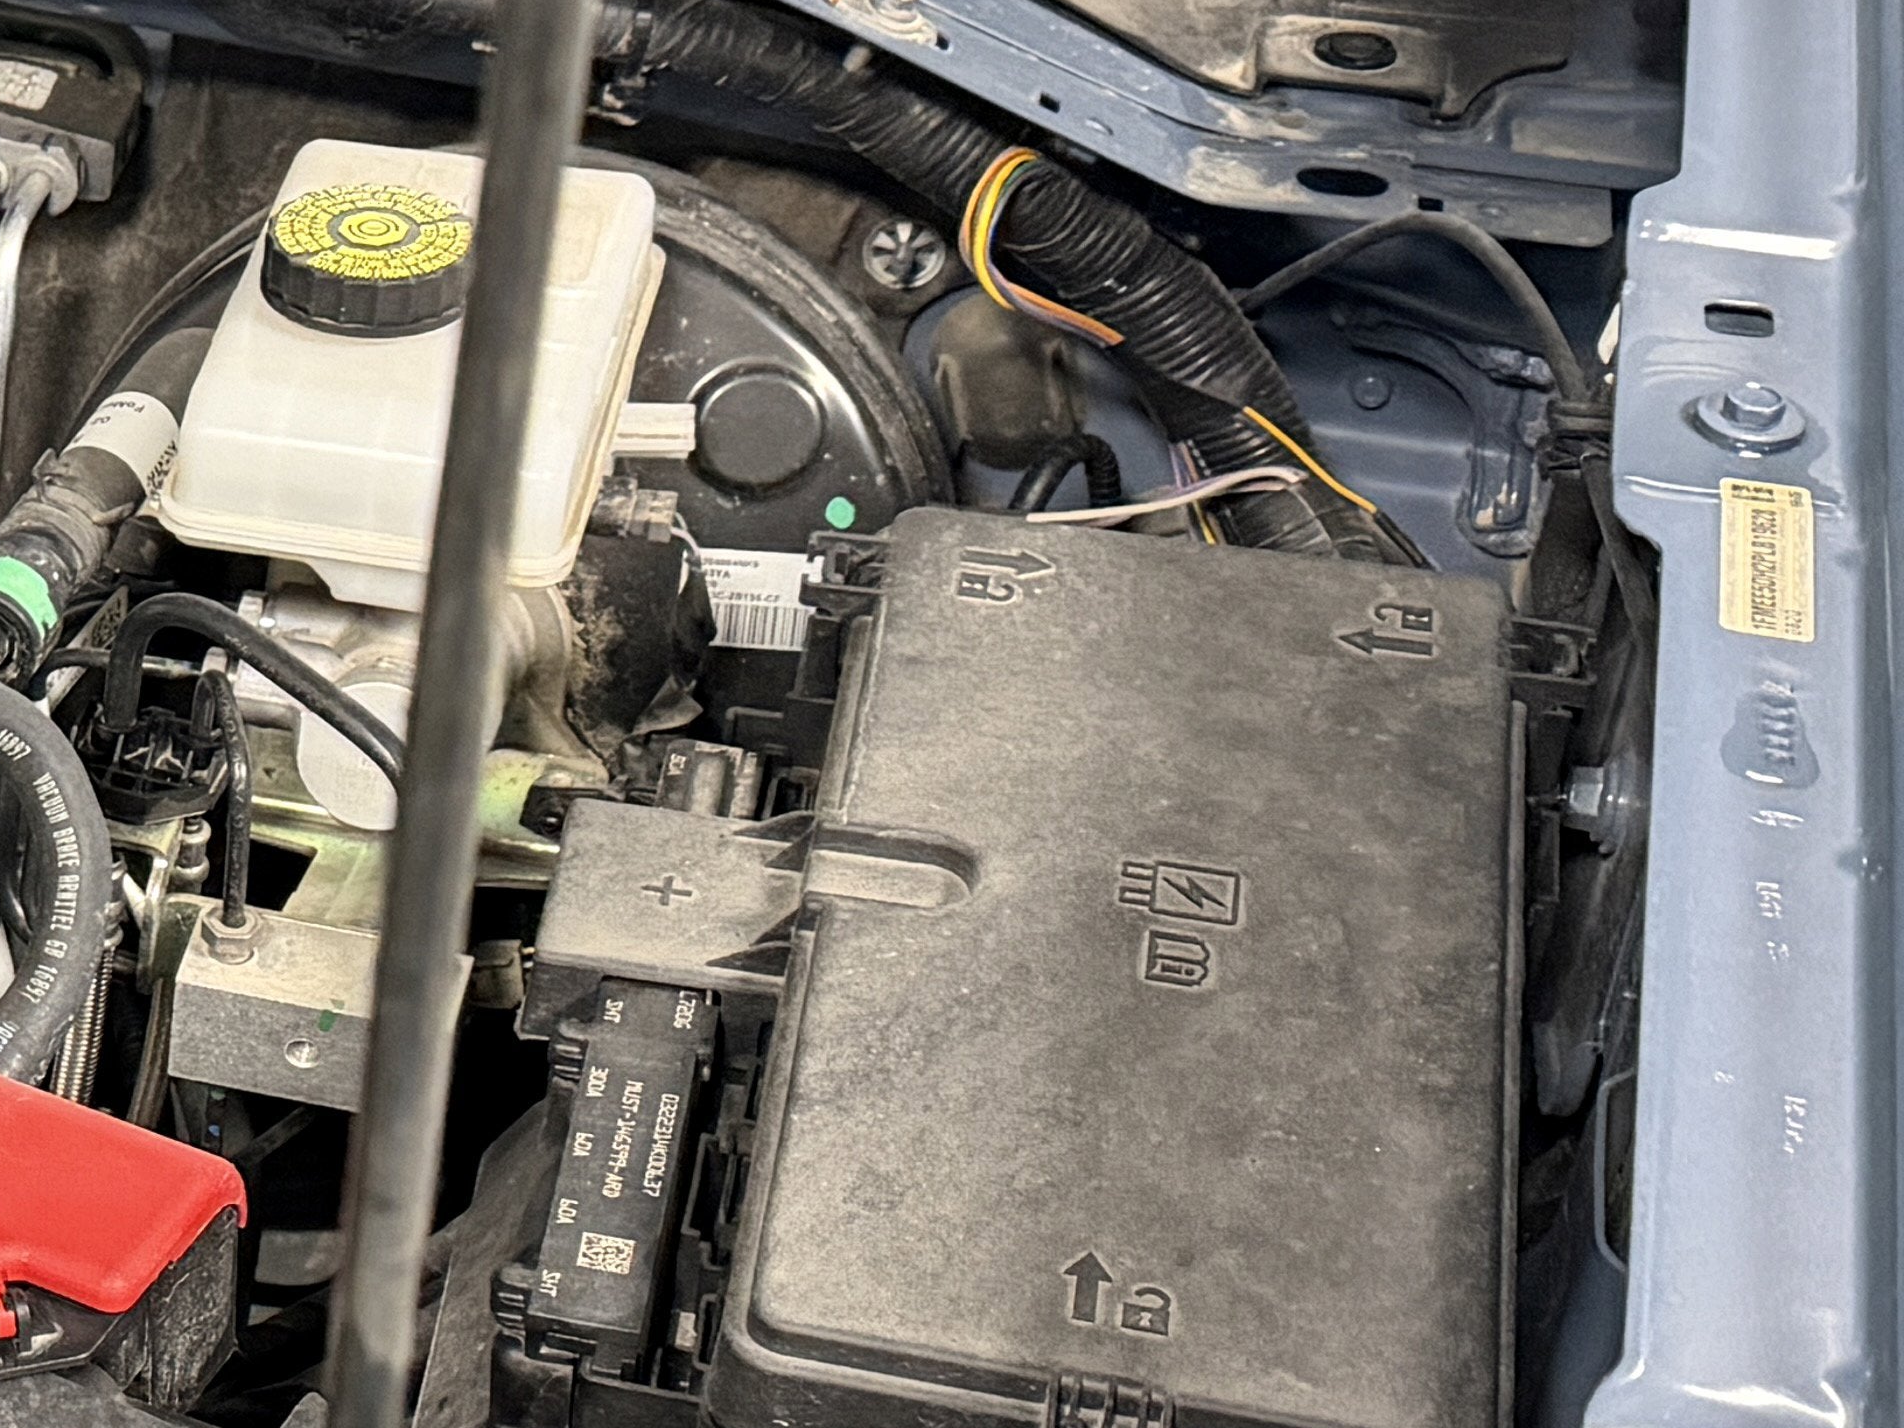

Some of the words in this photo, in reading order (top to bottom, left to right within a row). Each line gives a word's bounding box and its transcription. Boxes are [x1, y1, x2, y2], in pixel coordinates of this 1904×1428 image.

[32, 772, 68, 824] VACUUM
[51, 826, 79, 867] BRAKE
[49, 873, 78, 929] ARNITEL
[17, 964, 57, 1003] 16897
